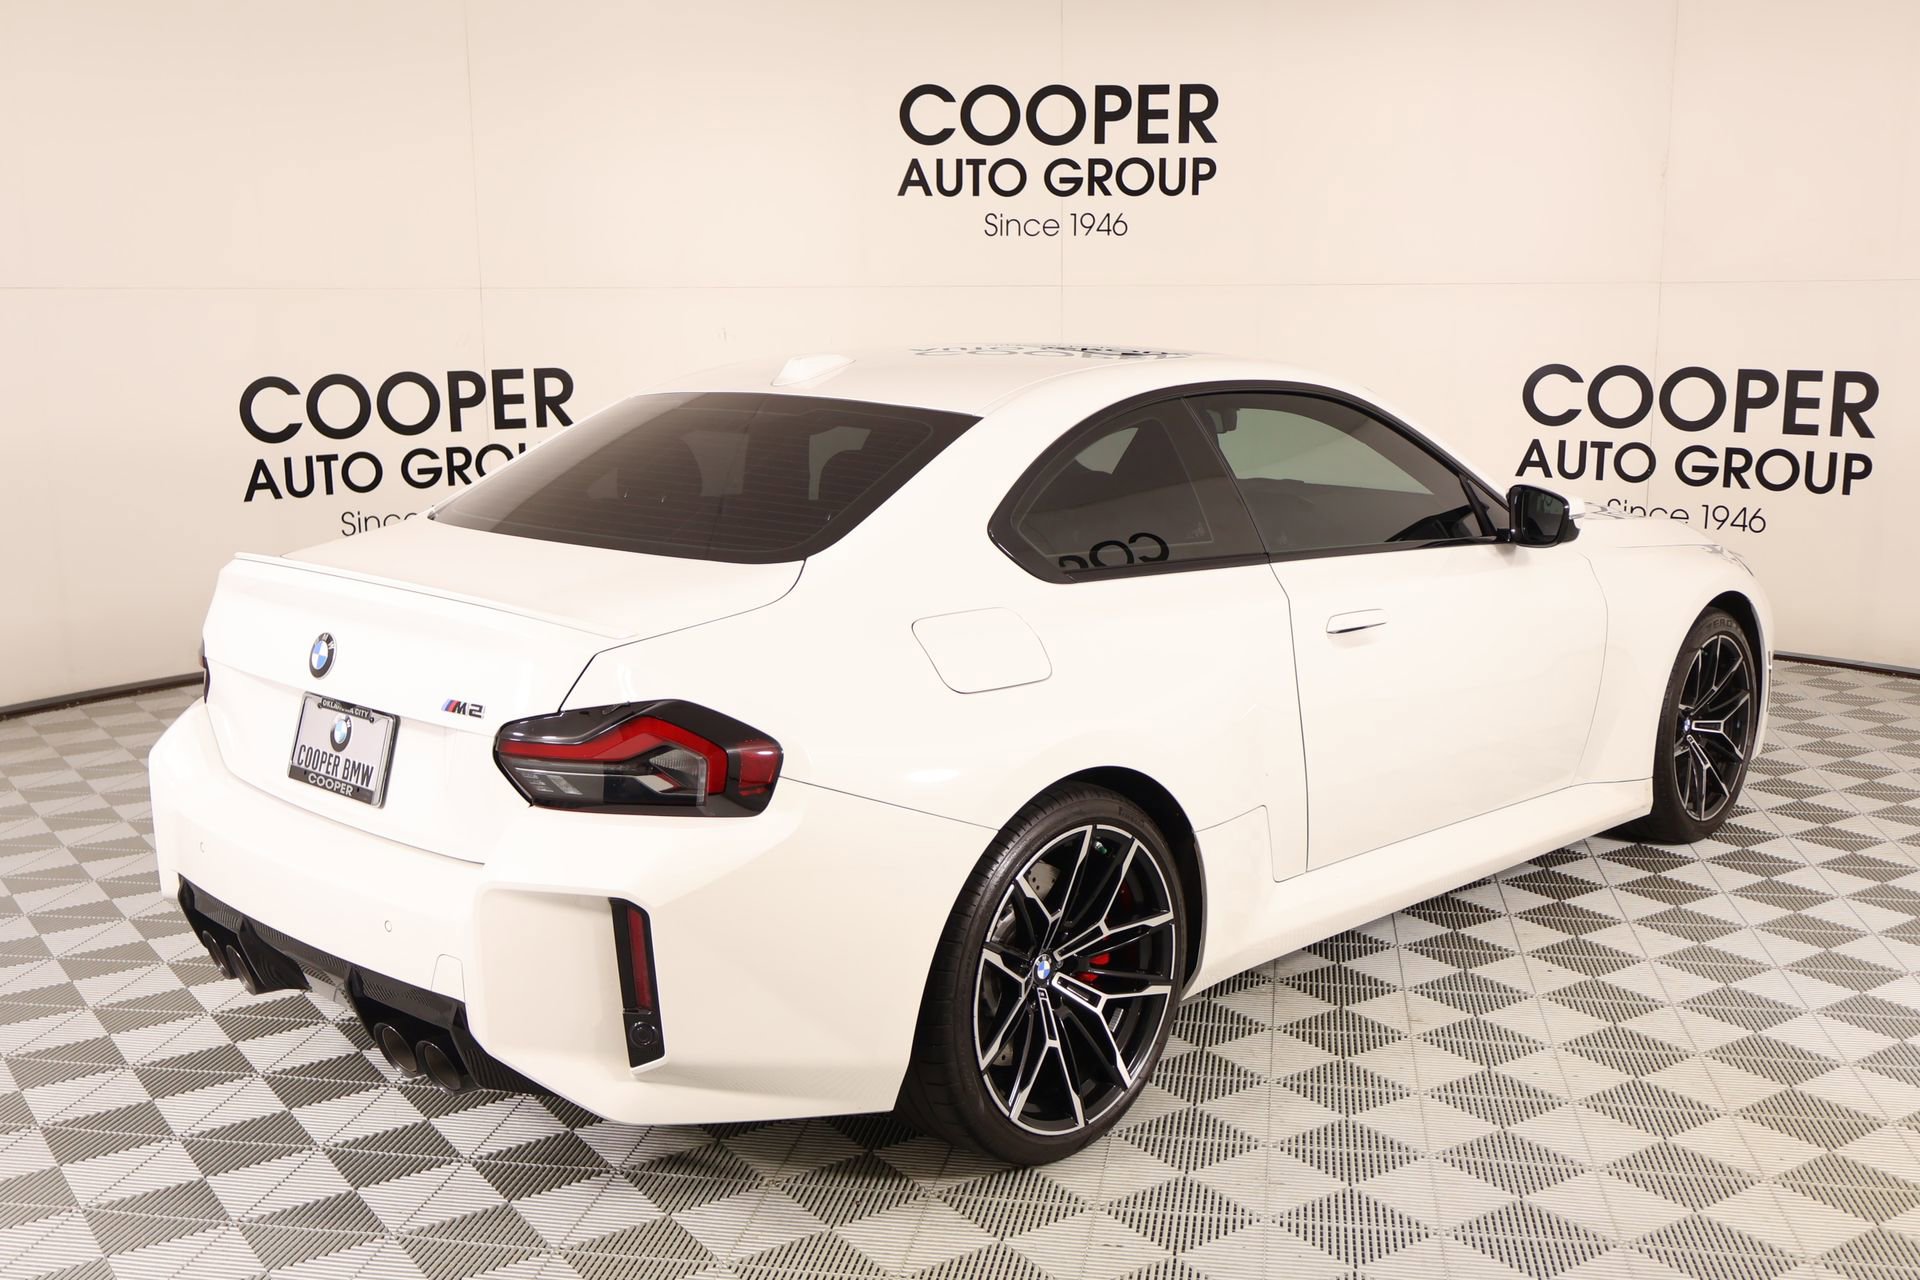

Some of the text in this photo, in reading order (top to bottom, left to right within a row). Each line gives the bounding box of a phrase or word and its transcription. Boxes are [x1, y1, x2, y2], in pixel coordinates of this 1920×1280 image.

[899, 83, 1219, 146] COOPER
[897, 157, 1217, 197] AUTO GROUP
[984, 212, 1128, 237] Since 1946
[239, 367, 575, 443] COOPER
[1522, 363, 1880, 439] COOPER
[243, 442, 527, 503] AUTO GRO
[1515, 438, 1873, 496] AUTO GROUP
[1702, 504, 1767, 533] 1946
[354, 707, 369, 718] CITY
[446, 700, 484, 718] M2
[297, 744, 374, 787] COOPER BMW
[308, 772, 354, 796] COOPER
